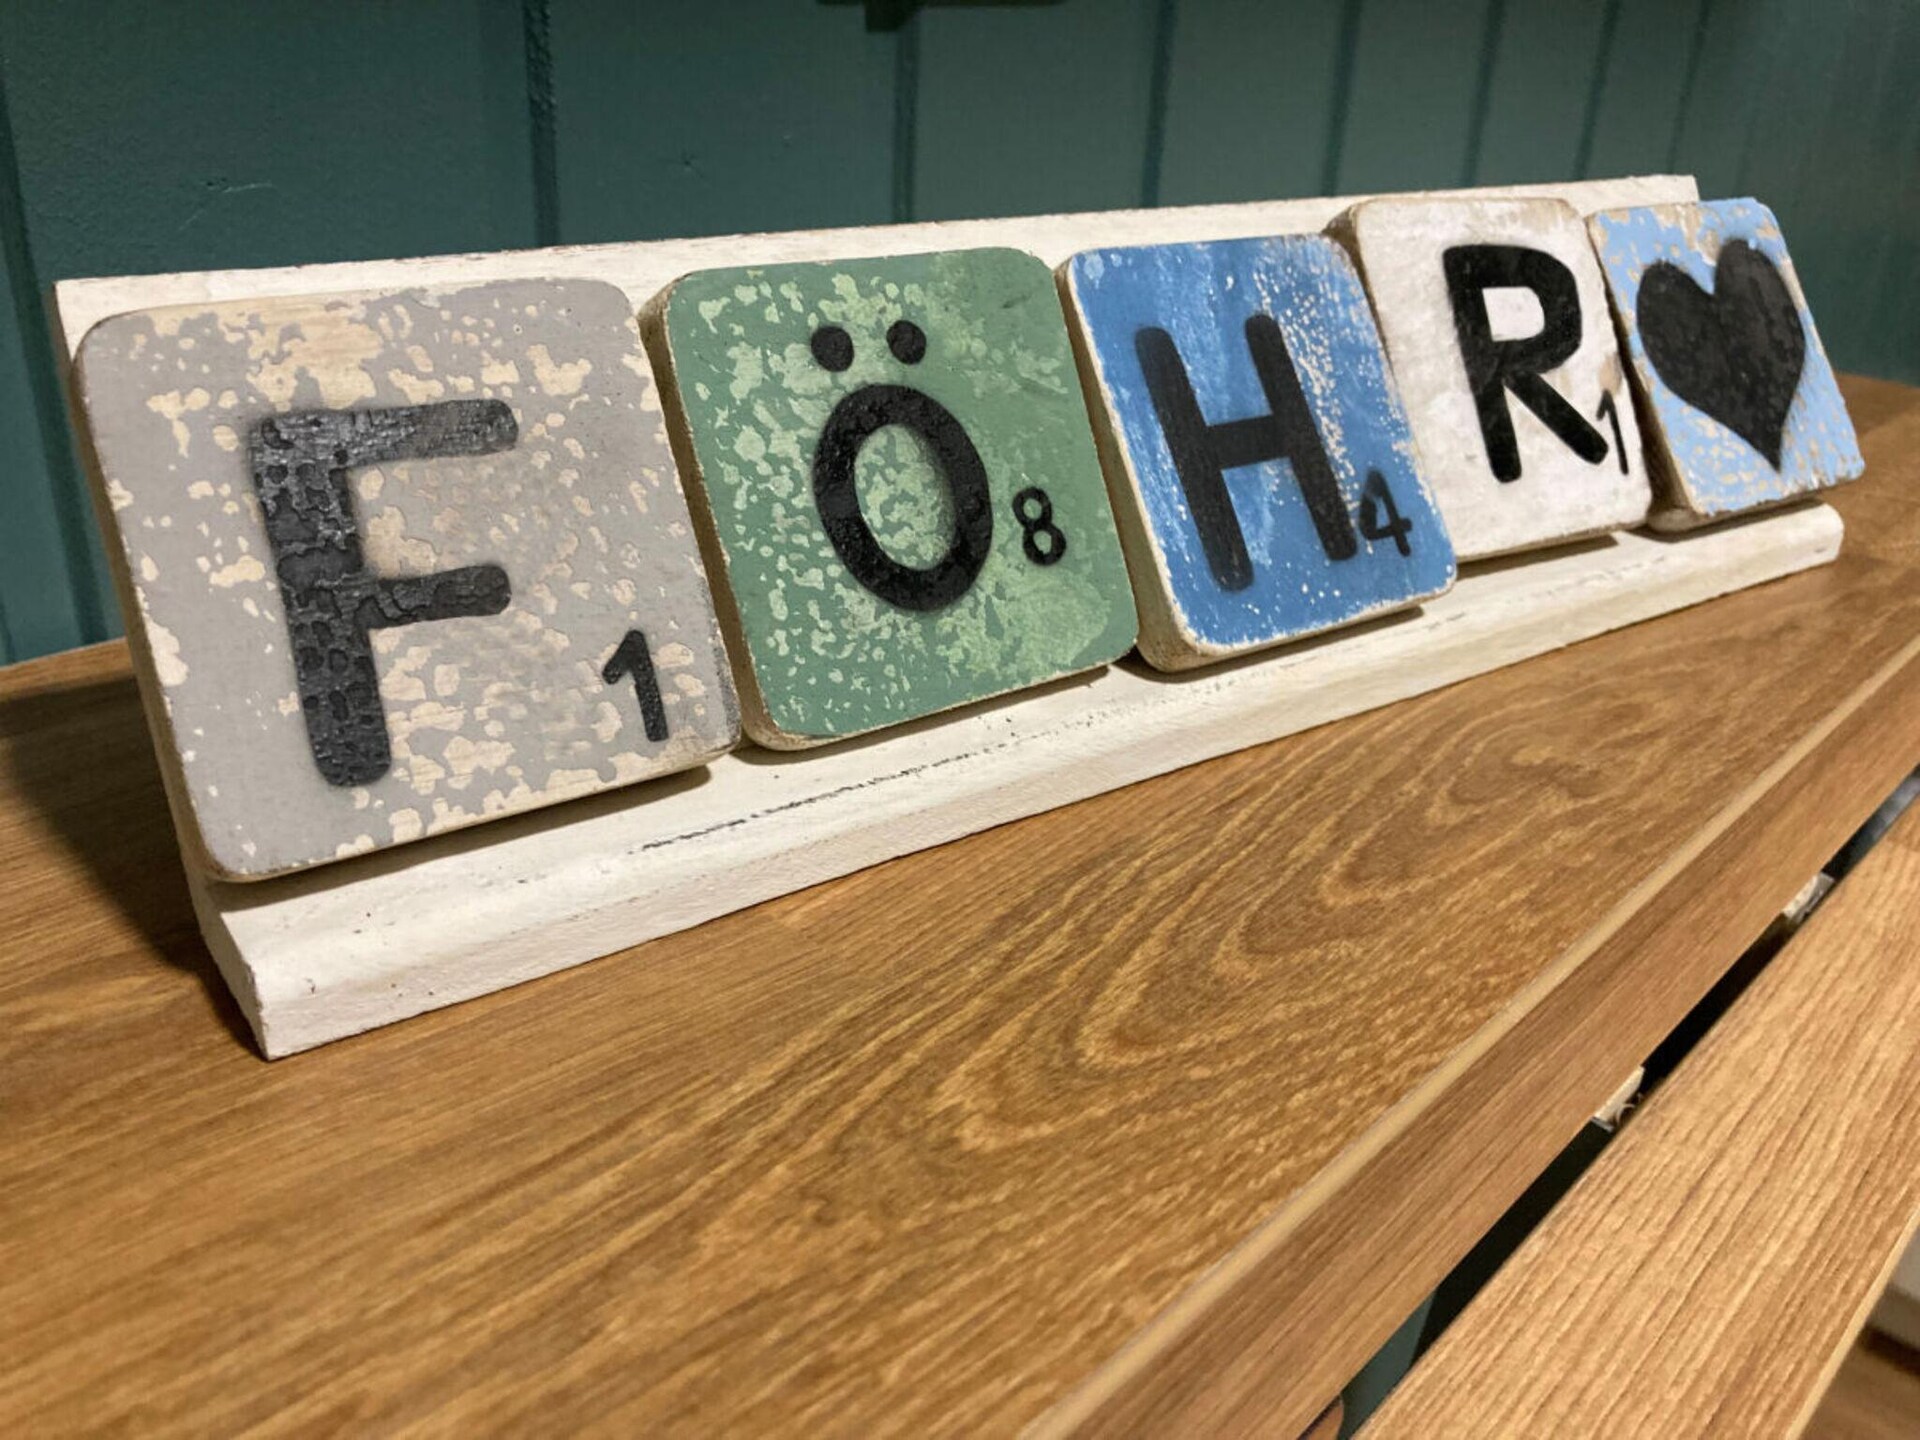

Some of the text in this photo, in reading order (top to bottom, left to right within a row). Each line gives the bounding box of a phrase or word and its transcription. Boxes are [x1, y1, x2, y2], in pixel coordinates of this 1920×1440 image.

[1595, 388, 1630, 476] 1
[1011, 484, 1068, 567] 8
[1357, 469, 1413, 558] 4
[601, 628, 670, 743] 1
